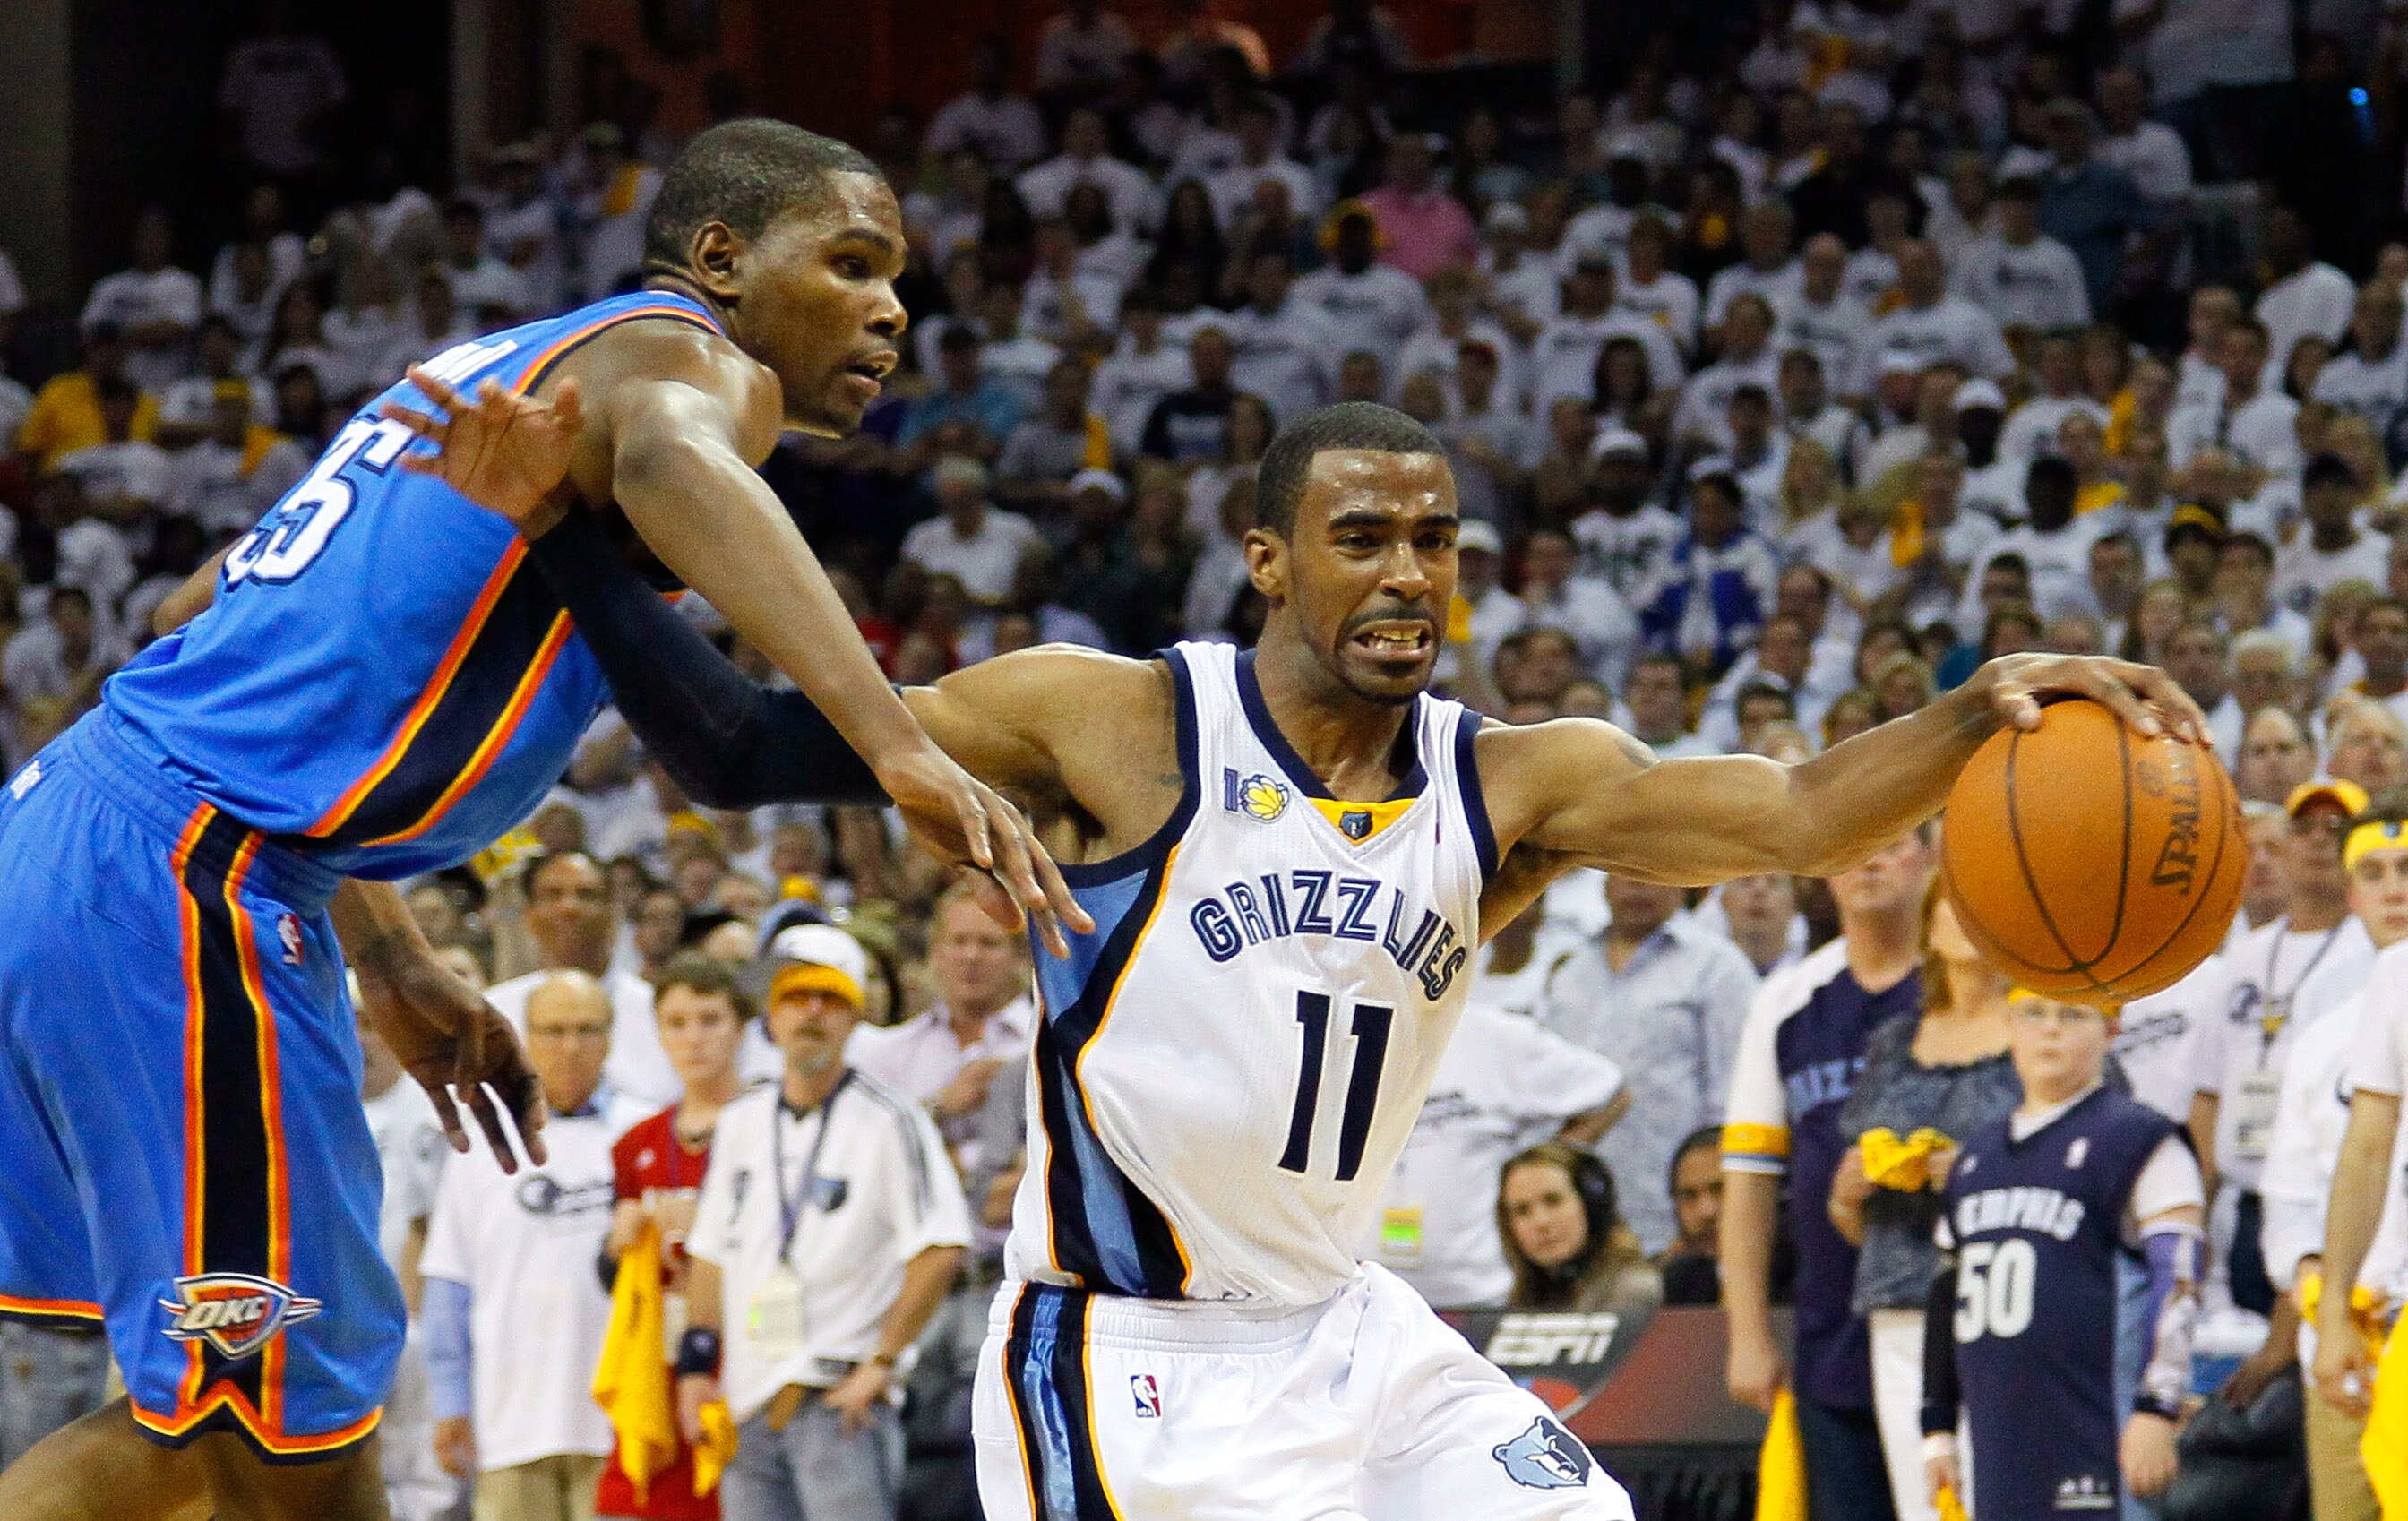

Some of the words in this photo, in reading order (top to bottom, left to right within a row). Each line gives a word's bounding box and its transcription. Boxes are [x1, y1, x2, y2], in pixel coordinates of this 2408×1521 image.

[1190, 870, 1466, 1001] GRIZZLIES
[1277, 989, 1394, 1181] 11
[182, 1295, 267, 1330] OKC
[1485, 1312, 1620, 1365] ESPN
[1953, 1237, 2038, 1344] 50
